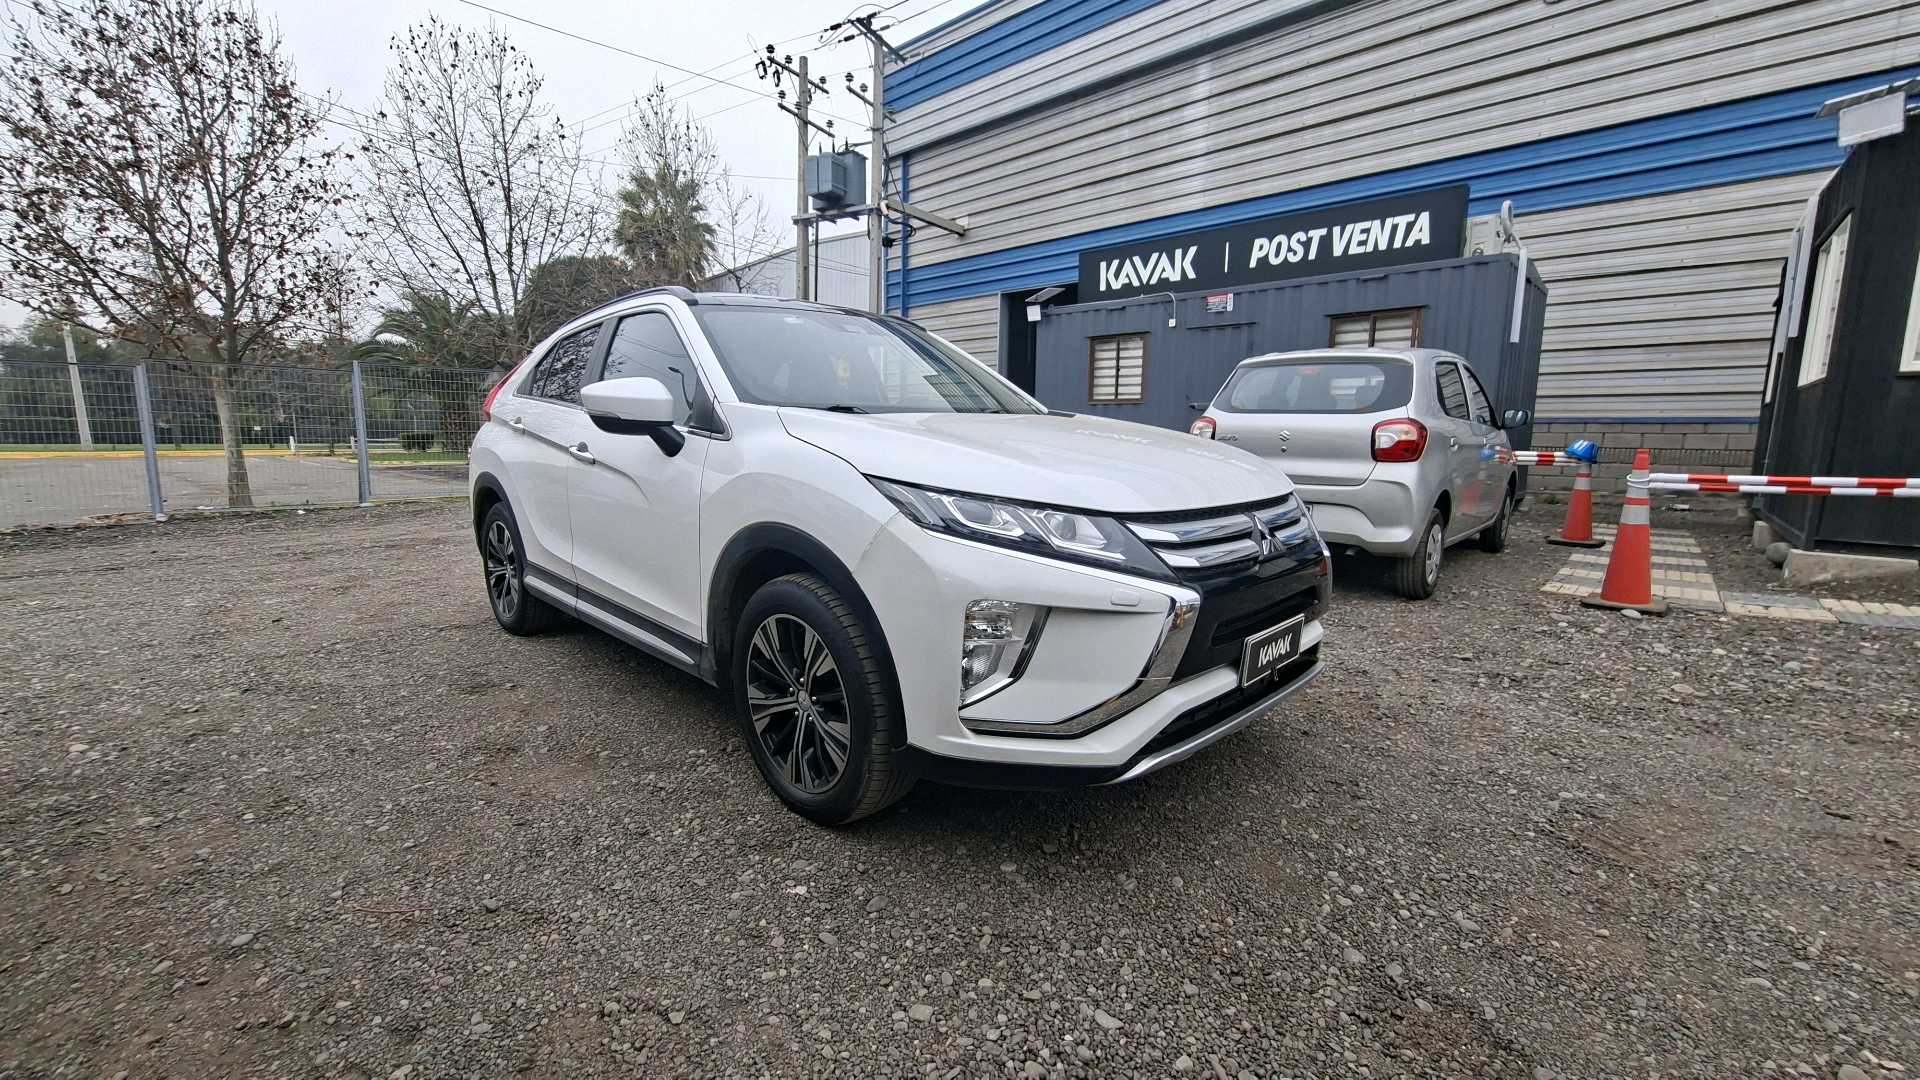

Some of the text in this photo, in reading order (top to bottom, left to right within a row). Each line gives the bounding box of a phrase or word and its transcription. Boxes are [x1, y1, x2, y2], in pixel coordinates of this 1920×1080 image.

[1099, 211, 1431, 292] KAVAK POST VENTA
[1257, 632, 1293, 668] KAVAK
